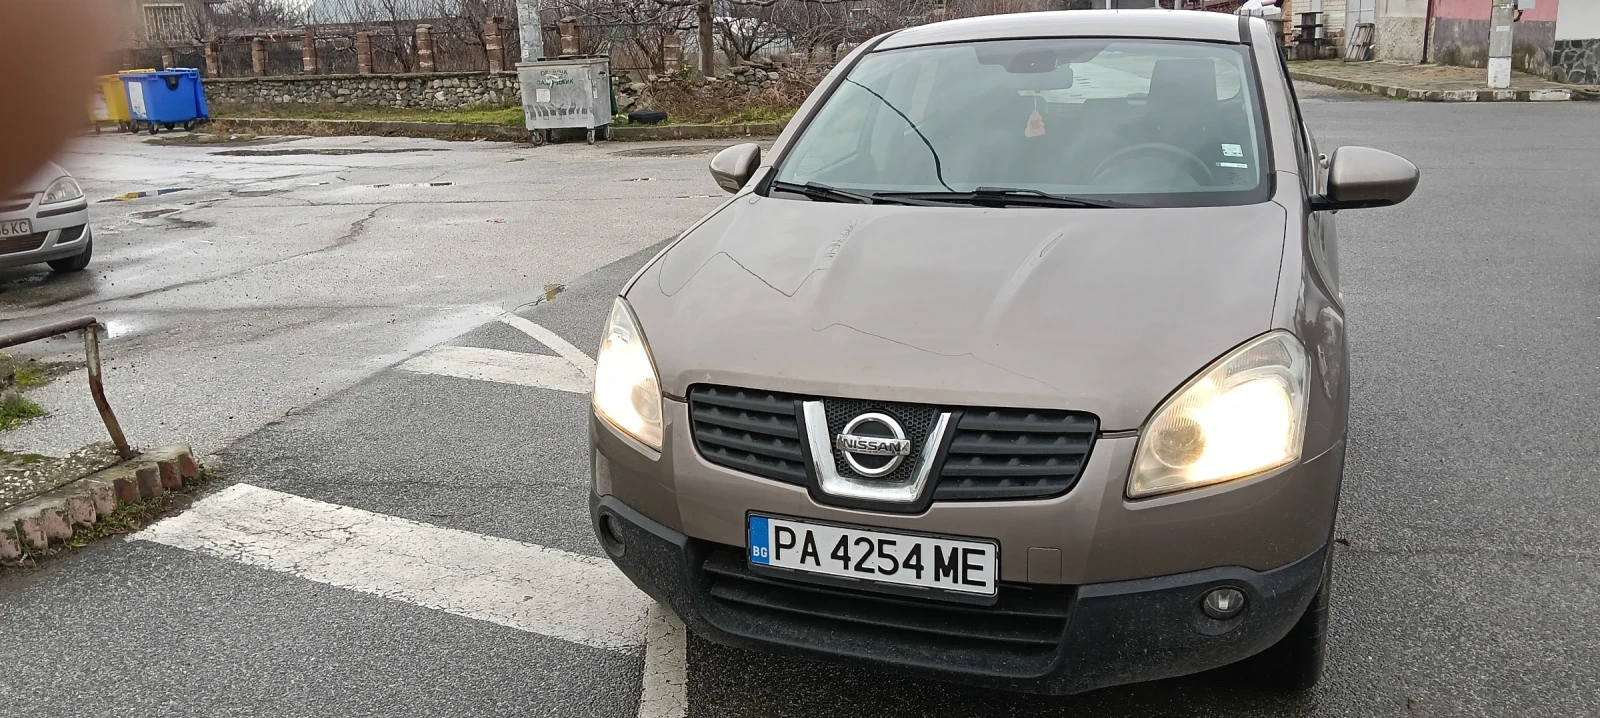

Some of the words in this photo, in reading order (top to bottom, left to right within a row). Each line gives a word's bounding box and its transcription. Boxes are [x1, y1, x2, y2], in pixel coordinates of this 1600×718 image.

[843, 438, 901, 453] NISSAN
[753, 545, 768, 558] BG
[774, 525, 821, 567] PA
[830, 534, 924, 580] 4254
[933, 545, 987, 588] ME
